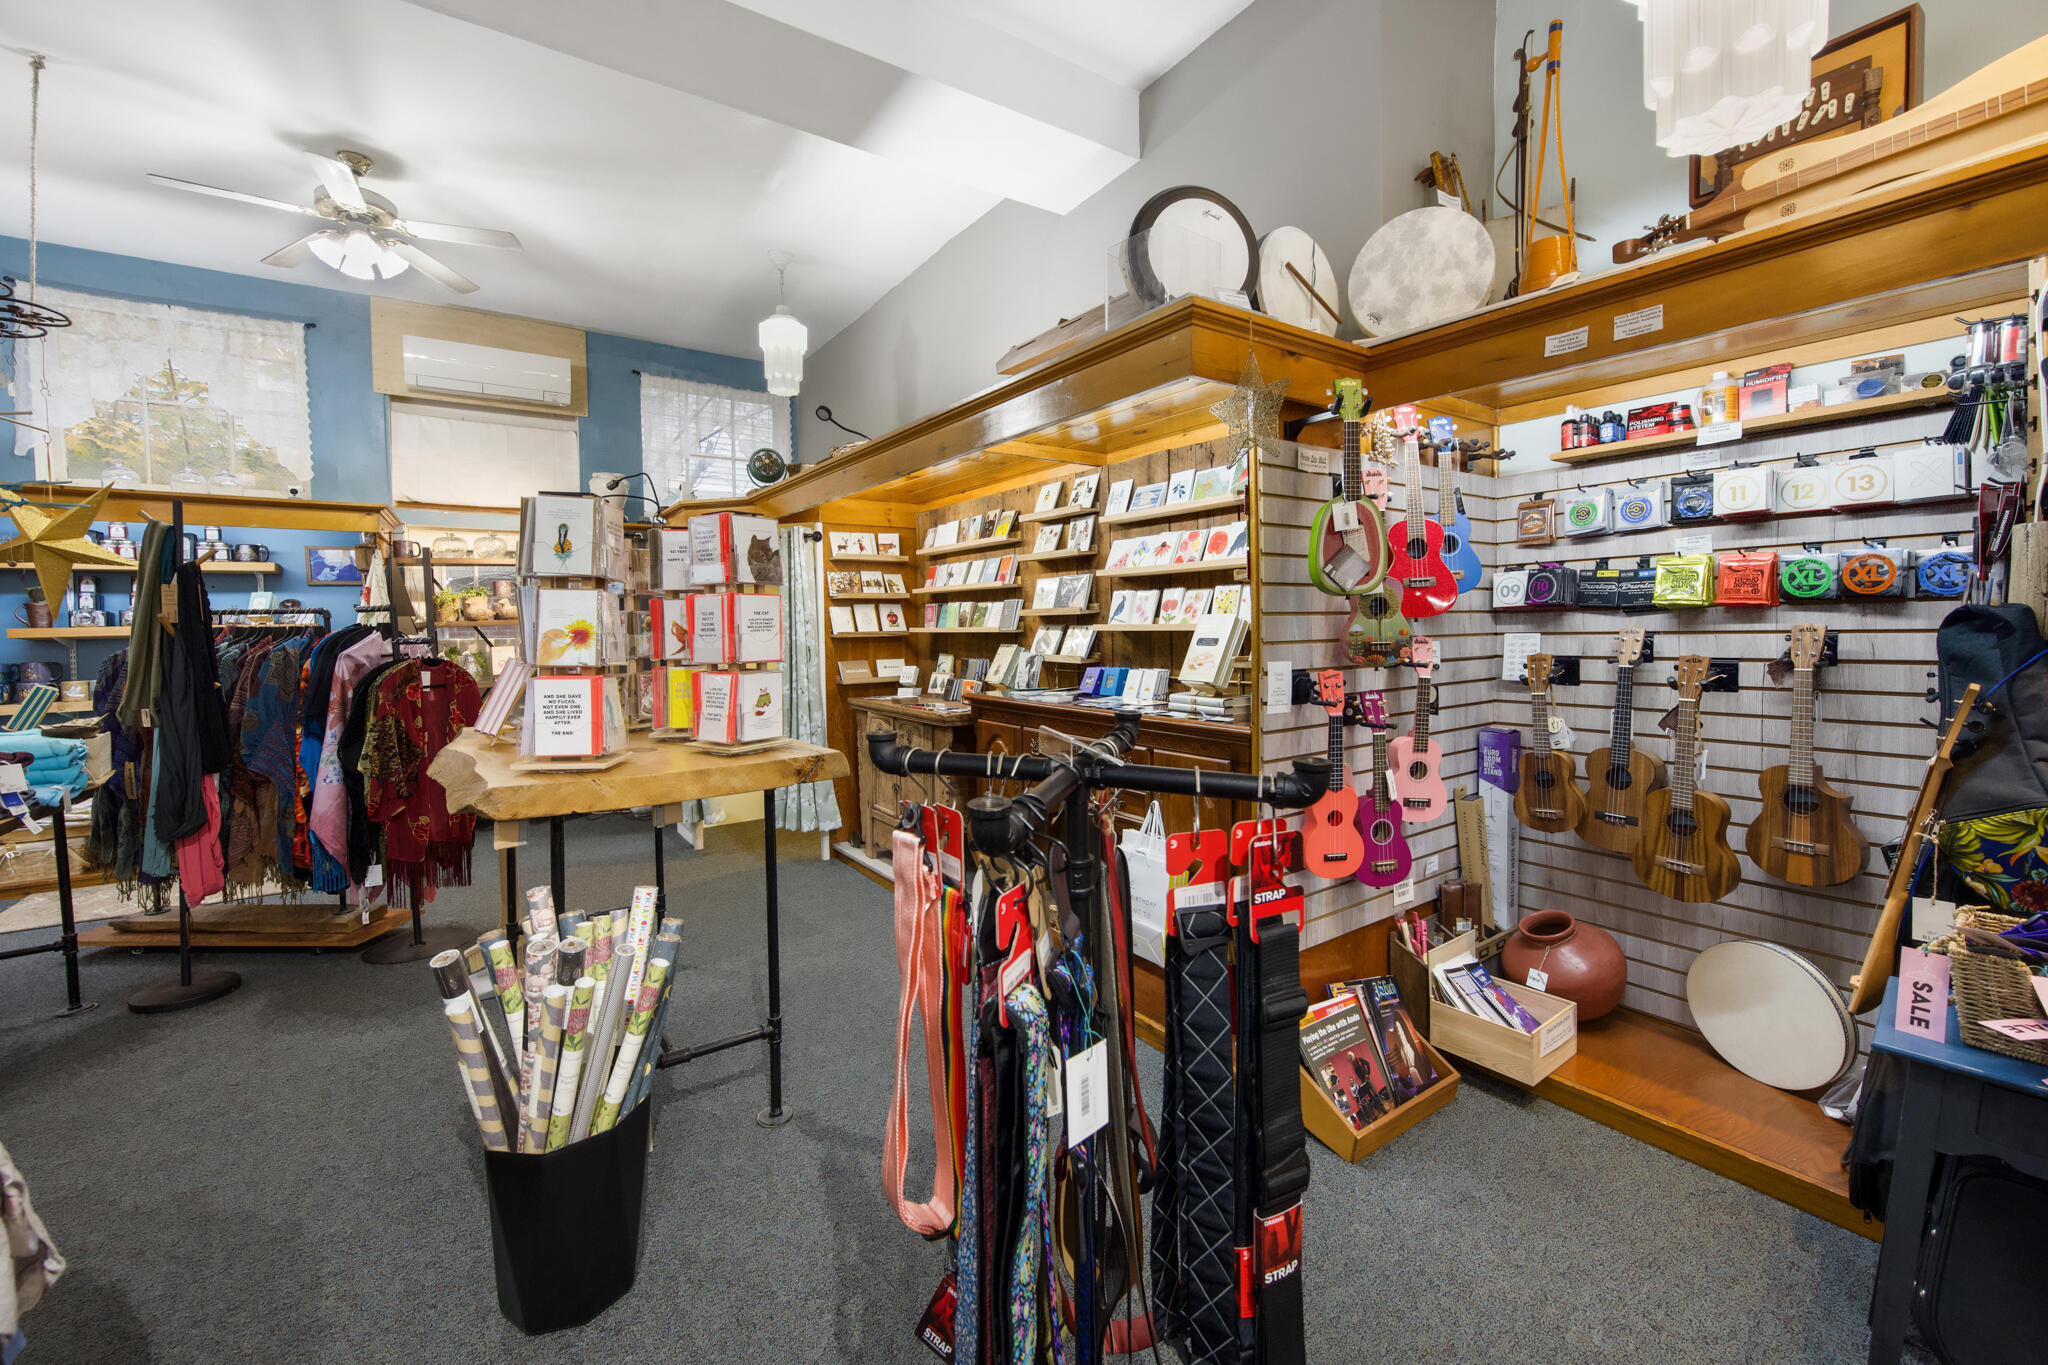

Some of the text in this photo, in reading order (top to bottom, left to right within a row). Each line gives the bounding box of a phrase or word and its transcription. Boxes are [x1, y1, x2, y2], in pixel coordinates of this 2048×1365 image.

[1746, 373, 1788, 387] HUMIDIFIER
[1628, 422, 1655, 432] SYSTEM
[1629, 416, 1664, 427] POLISHING
[1848, 474, 1875, 492] 13
[1730, 484, 1747, 502] 11
[1792, 483, 1816, 501] 12
[1791, 570, 1822, 586] XL
[1853, 565, 1885, 582] XL
[1930, 564, 1967, 582] XL
[1500, 584, 1521, 598] 09
[1537, 581, 1549, 592] 10
[1580, 583, 1616, 591] Dunlop
[1484, 748, 1500, 757] EURO
[1484, 754, 1501, 764] BOOM
[1484, 768, 1502, 777] STAND
[1476, 811, 1487, 866] Hamilton
[1254, 888, 1286, 904] STRAP
[1910, 980, 1933, 1030] SALE
[1302, 1032, 1320, 1045] Playing
[1318, 1028, 1328, 1038] the
[1336, 1018, 1348, 1030] with
[1264, 1260, 1298, 1284] STRAP
[924, 1327, 952, 1354] STRAP
